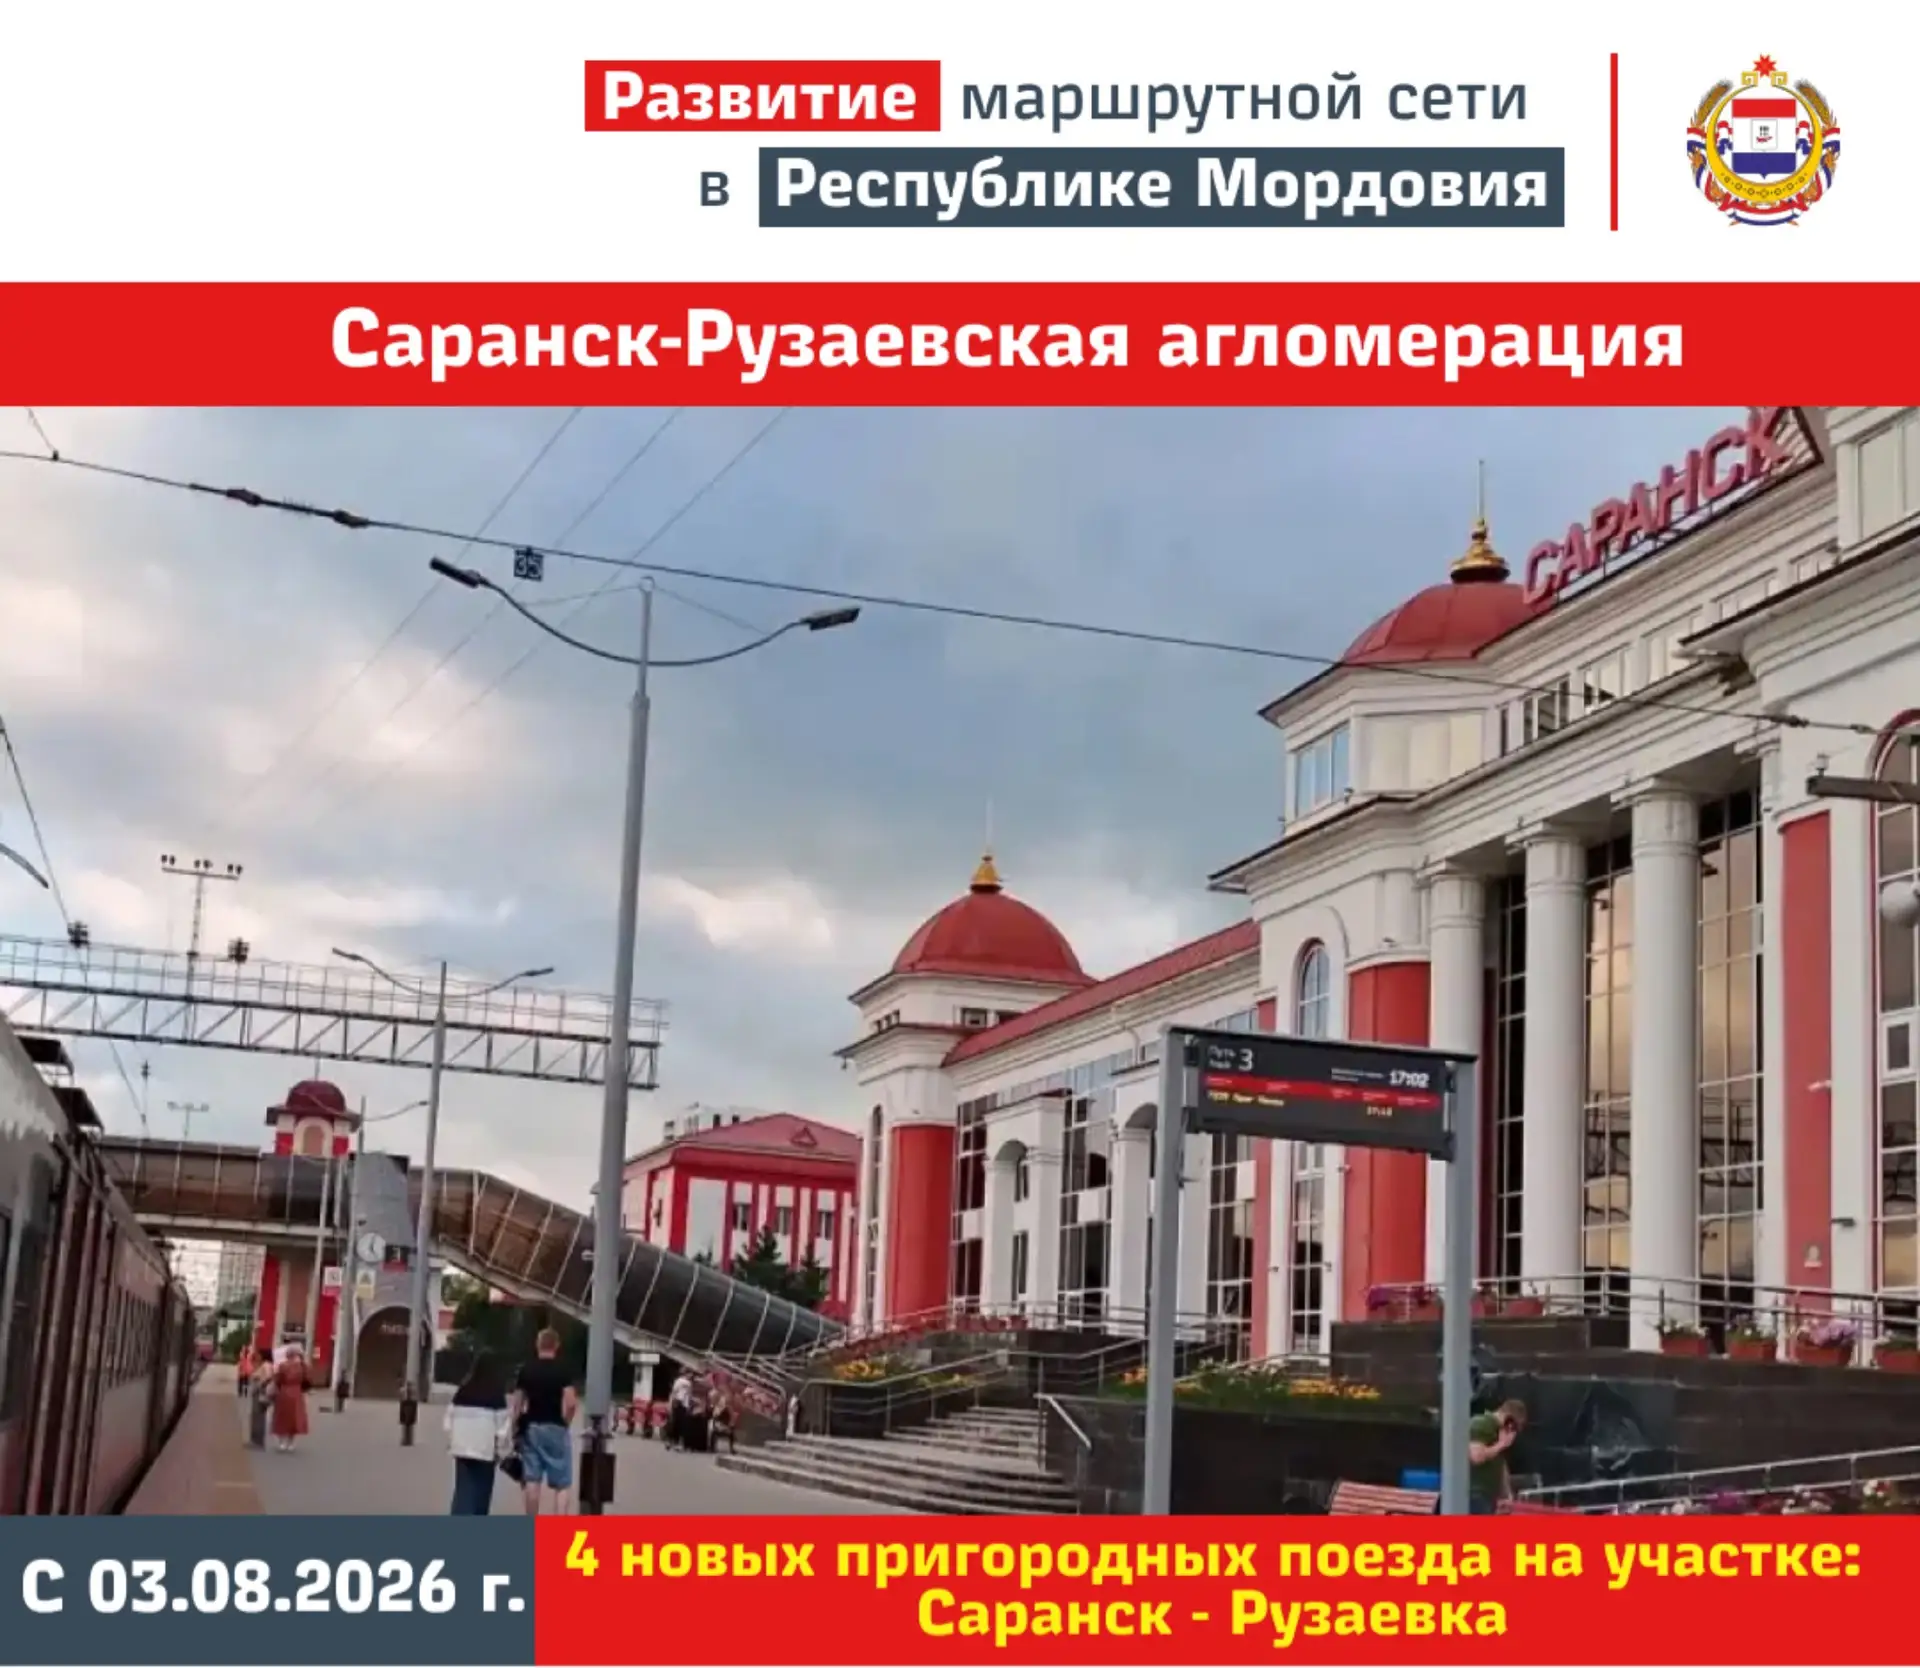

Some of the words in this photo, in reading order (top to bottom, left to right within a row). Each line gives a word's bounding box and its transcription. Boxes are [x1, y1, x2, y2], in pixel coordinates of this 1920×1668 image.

[1523, 407, 1792, 613] САРАНСК
[515, 554, 542, 579] 35
[1238, 1047, 1253, 1072] 3
[1389, 1069, 1430, 1089] 17:02
